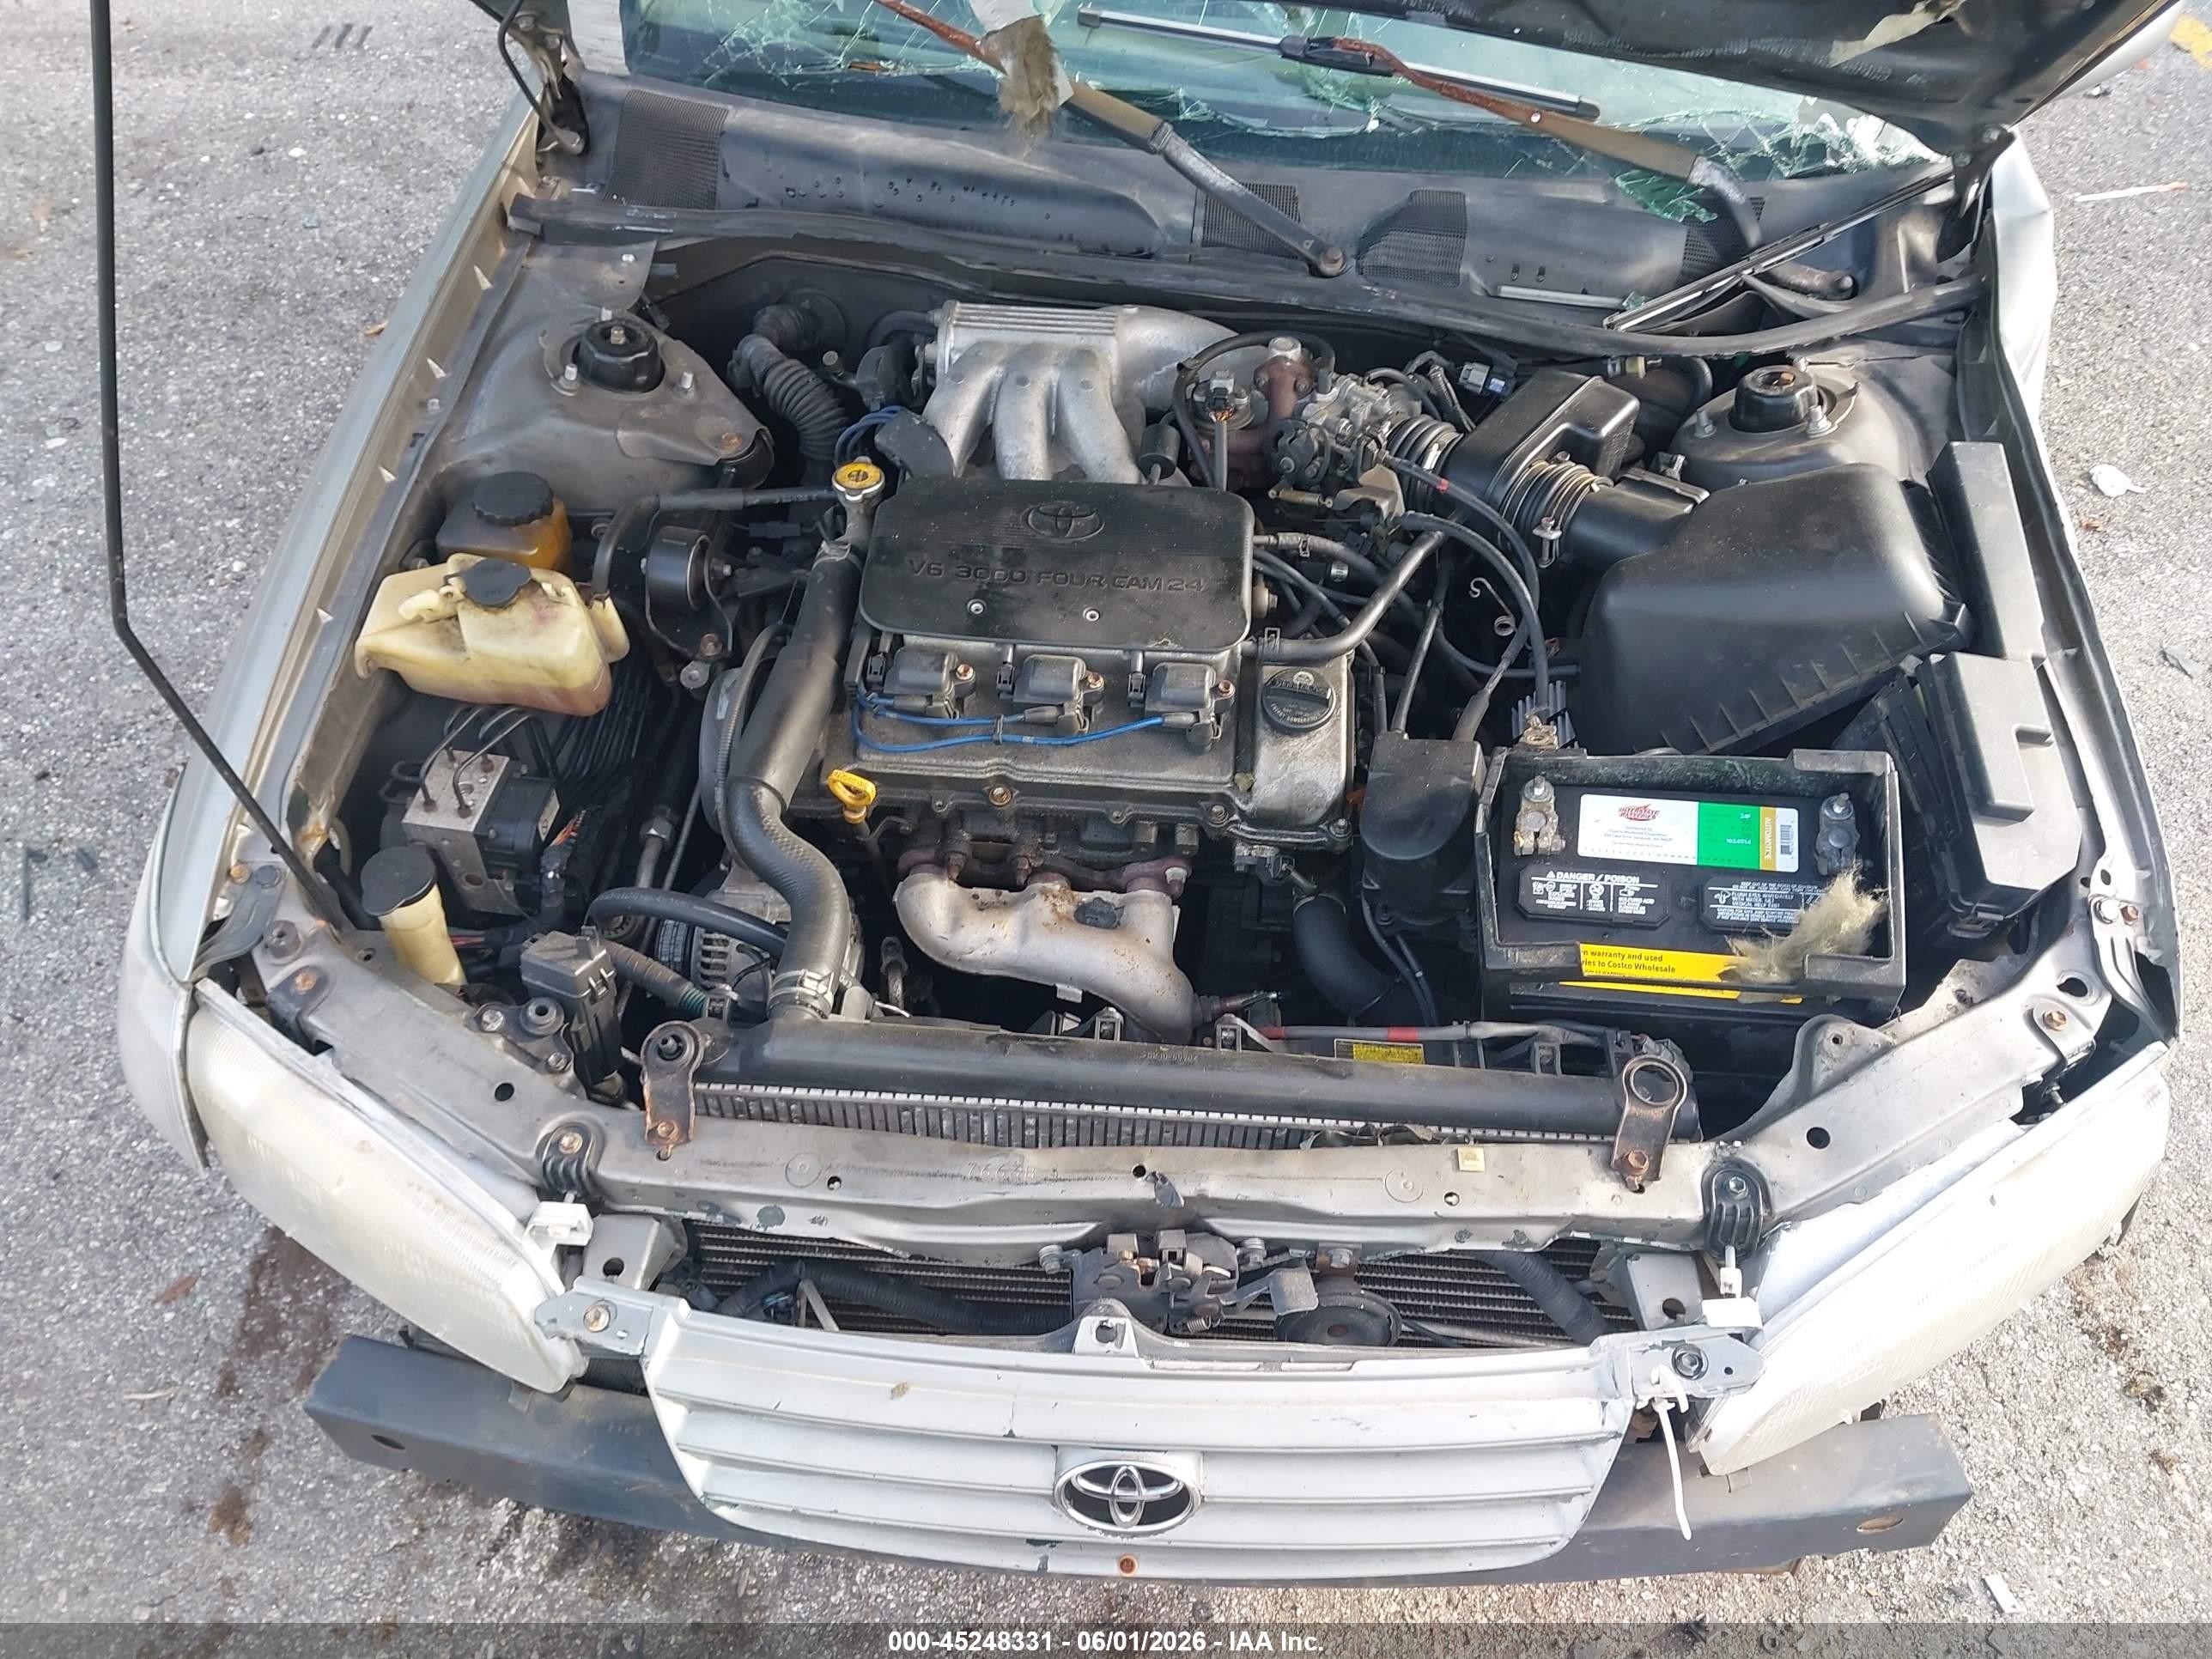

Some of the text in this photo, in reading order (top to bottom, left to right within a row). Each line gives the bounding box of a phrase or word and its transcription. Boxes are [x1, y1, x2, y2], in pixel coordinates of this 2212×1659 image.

[909, 558, 1205, 593] V6 3000 FOUR CAM 24
[1556, 872, 1595, 881] DANGER
[1604, 874, 1639, 884] POISON
[1589, 949, 1626, 961] warranty
[1607, 960, 1632, 969] Costco
[1634, 963, 1676, 973] Wholesale
